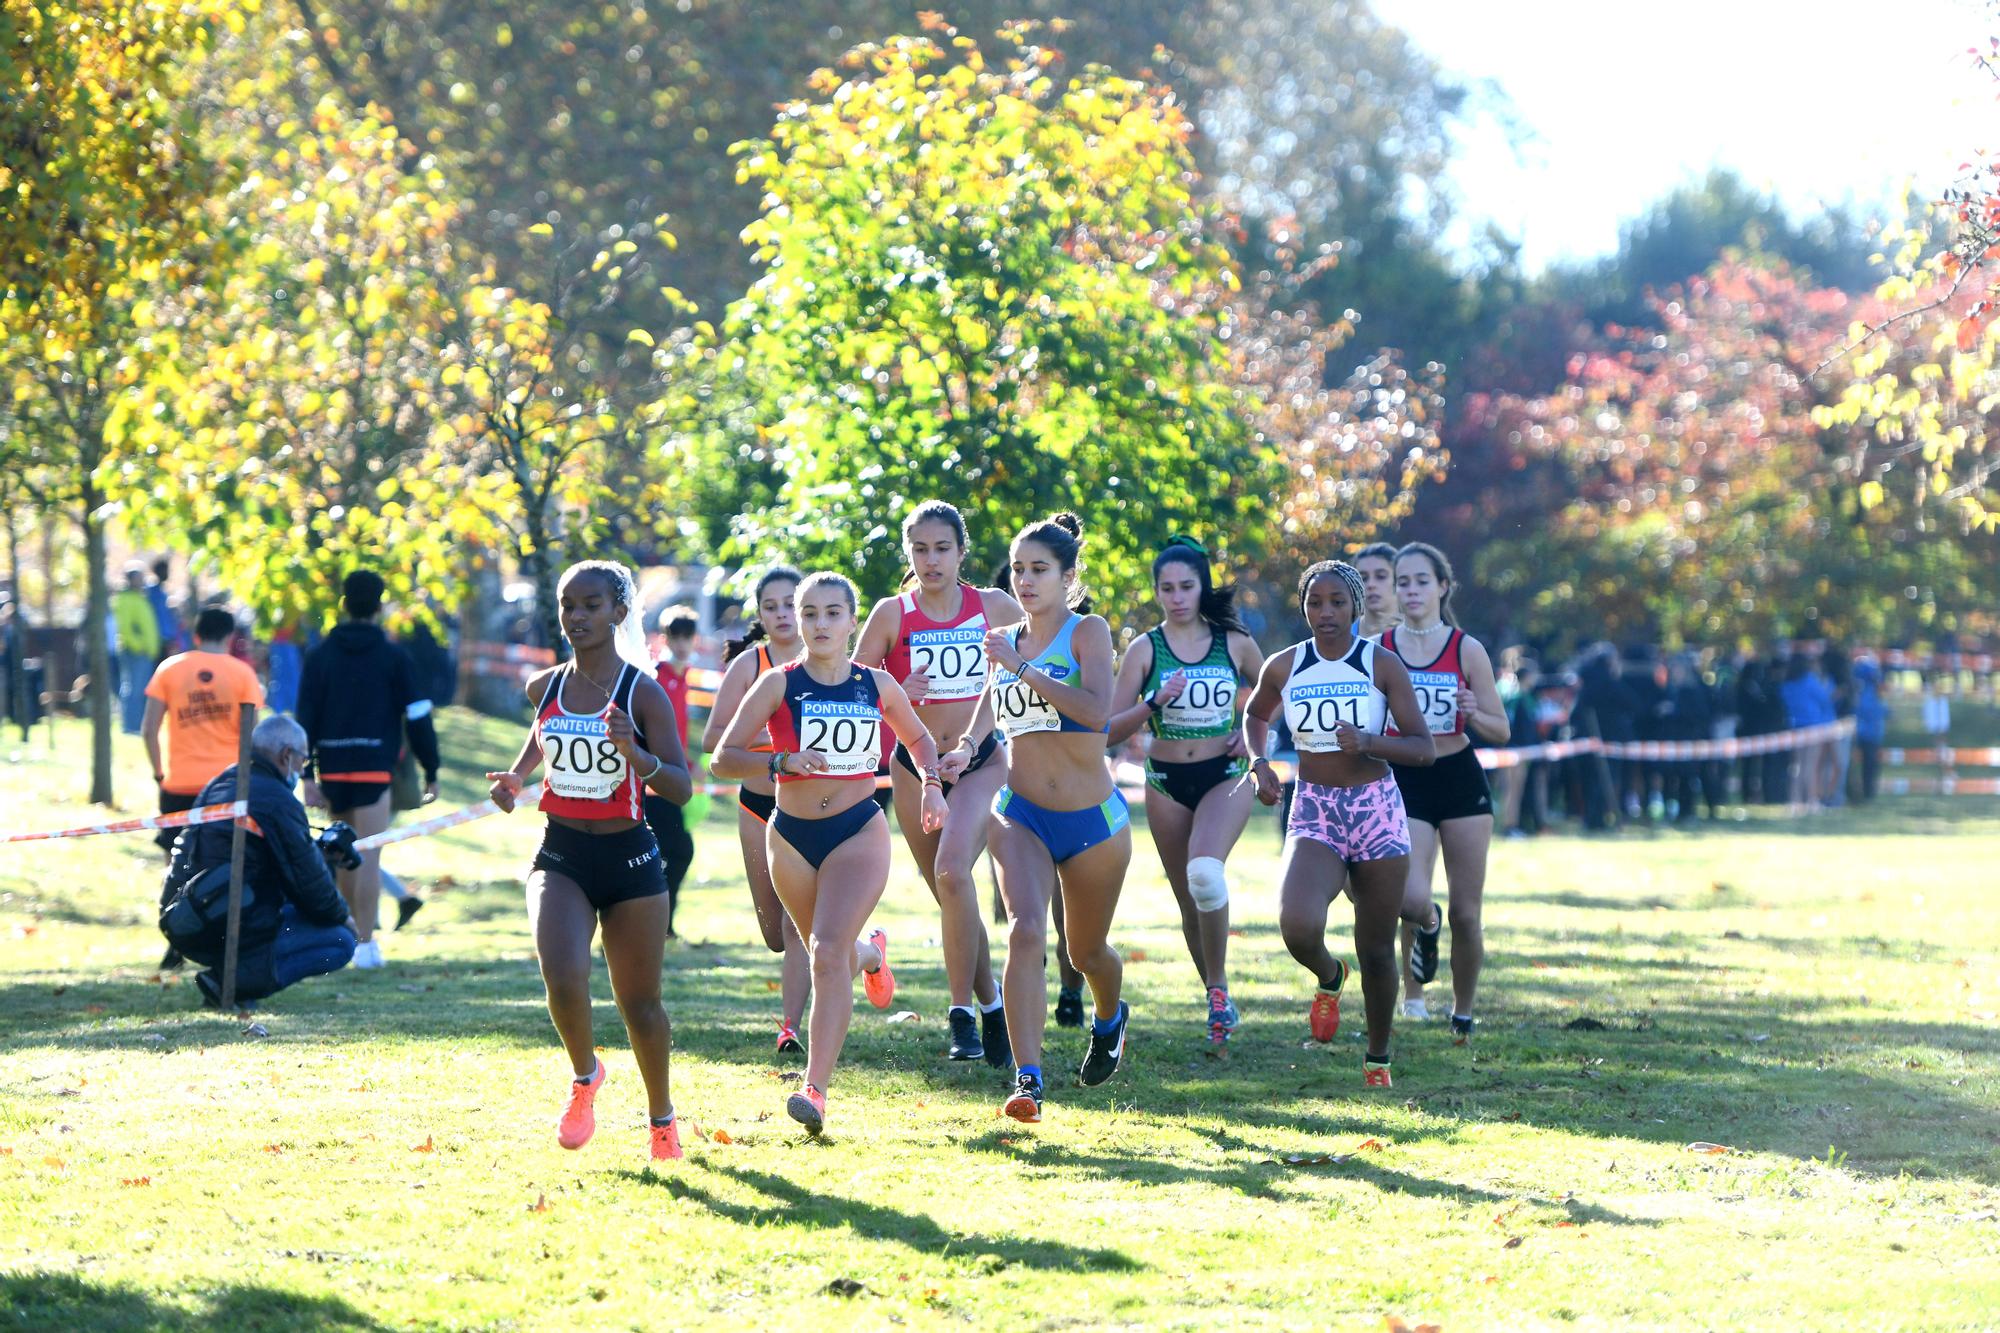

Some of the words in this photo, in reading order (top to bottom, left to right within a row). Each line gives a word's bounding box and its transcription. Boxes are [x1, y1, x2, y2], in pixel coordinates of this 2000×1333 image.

[912, 631, 983, 644] PONTEVEDRA
[916, 645, 984, 679] 202
[1162, 667, 1234, 679] PTEVEDRA
[1410, 673, 1458, 684] TEVEDRA
[1292, 684, 1369, 698] PONTEVEDRA
[1414, 687, 1452, 717] 05
[804, 703, 880, 717] PONTEVEDRA
[1295, 699, 1365, 733] 201
[543, 719, 609, 733] PONTEVED
[806, 718, 876, 753] 207
[545, 735, 621, 774] 208
